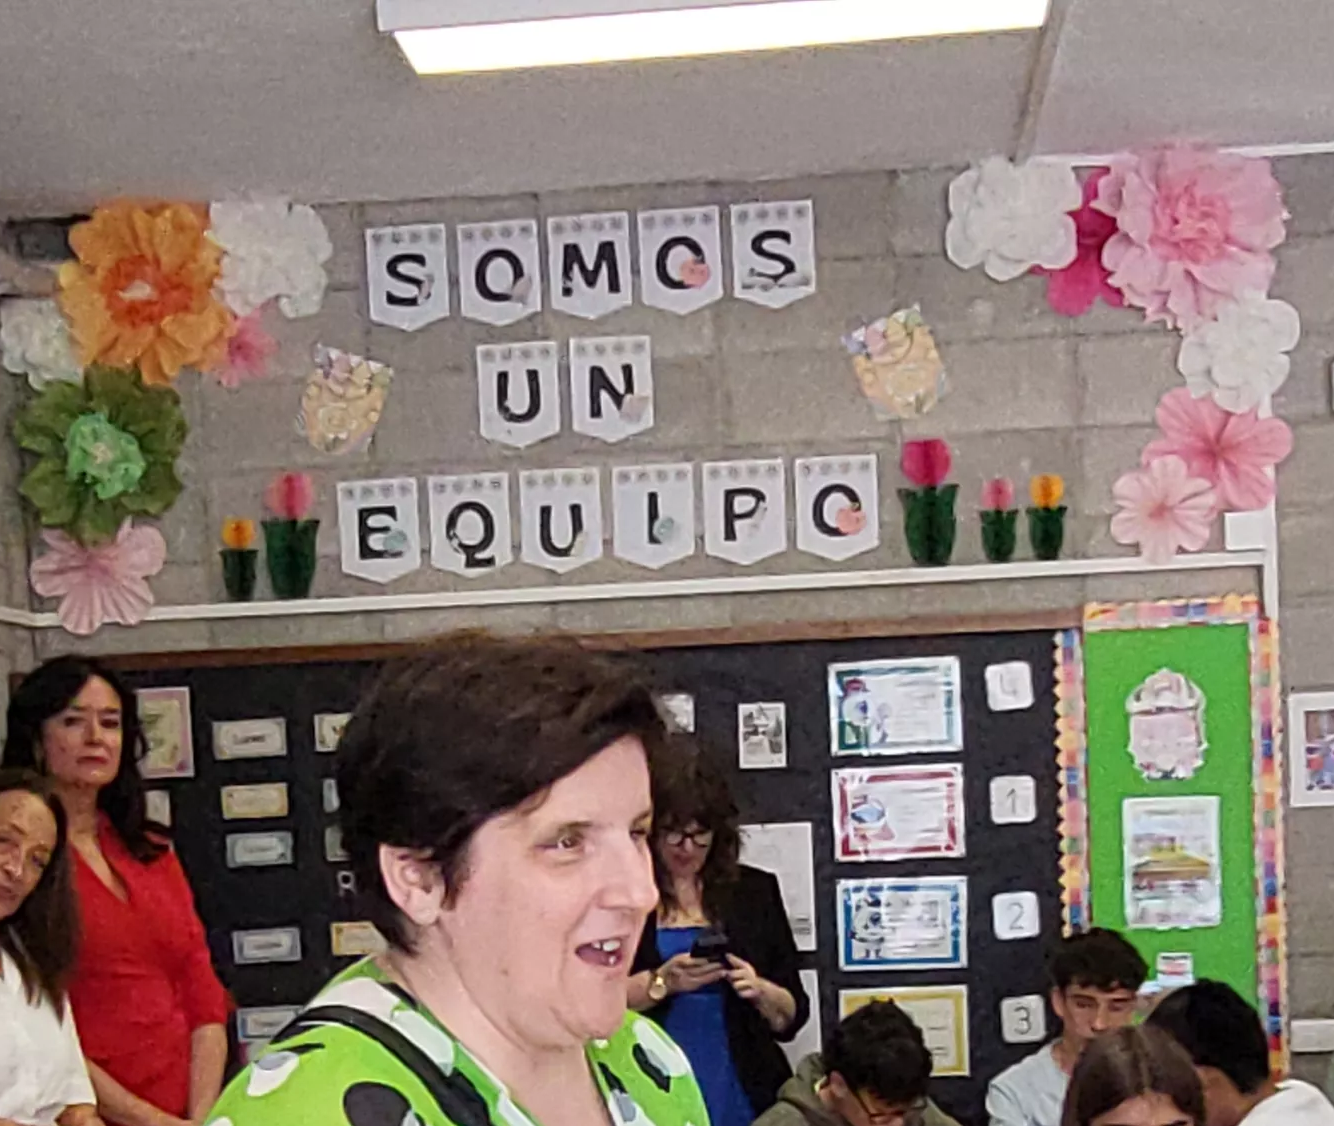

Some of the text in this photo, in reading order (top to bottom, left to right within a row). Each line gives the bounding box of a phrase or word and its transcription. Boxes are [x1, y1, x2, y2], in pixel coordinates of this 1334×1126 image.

[385, 229, 798, 307] SOMOS
[496, 363, 636, 423] UN
[358, 482, 863, 568] EQUIPO
[1006, 902, 1025, 930] 2
[1013, 1005, 1032, 1035] 3
